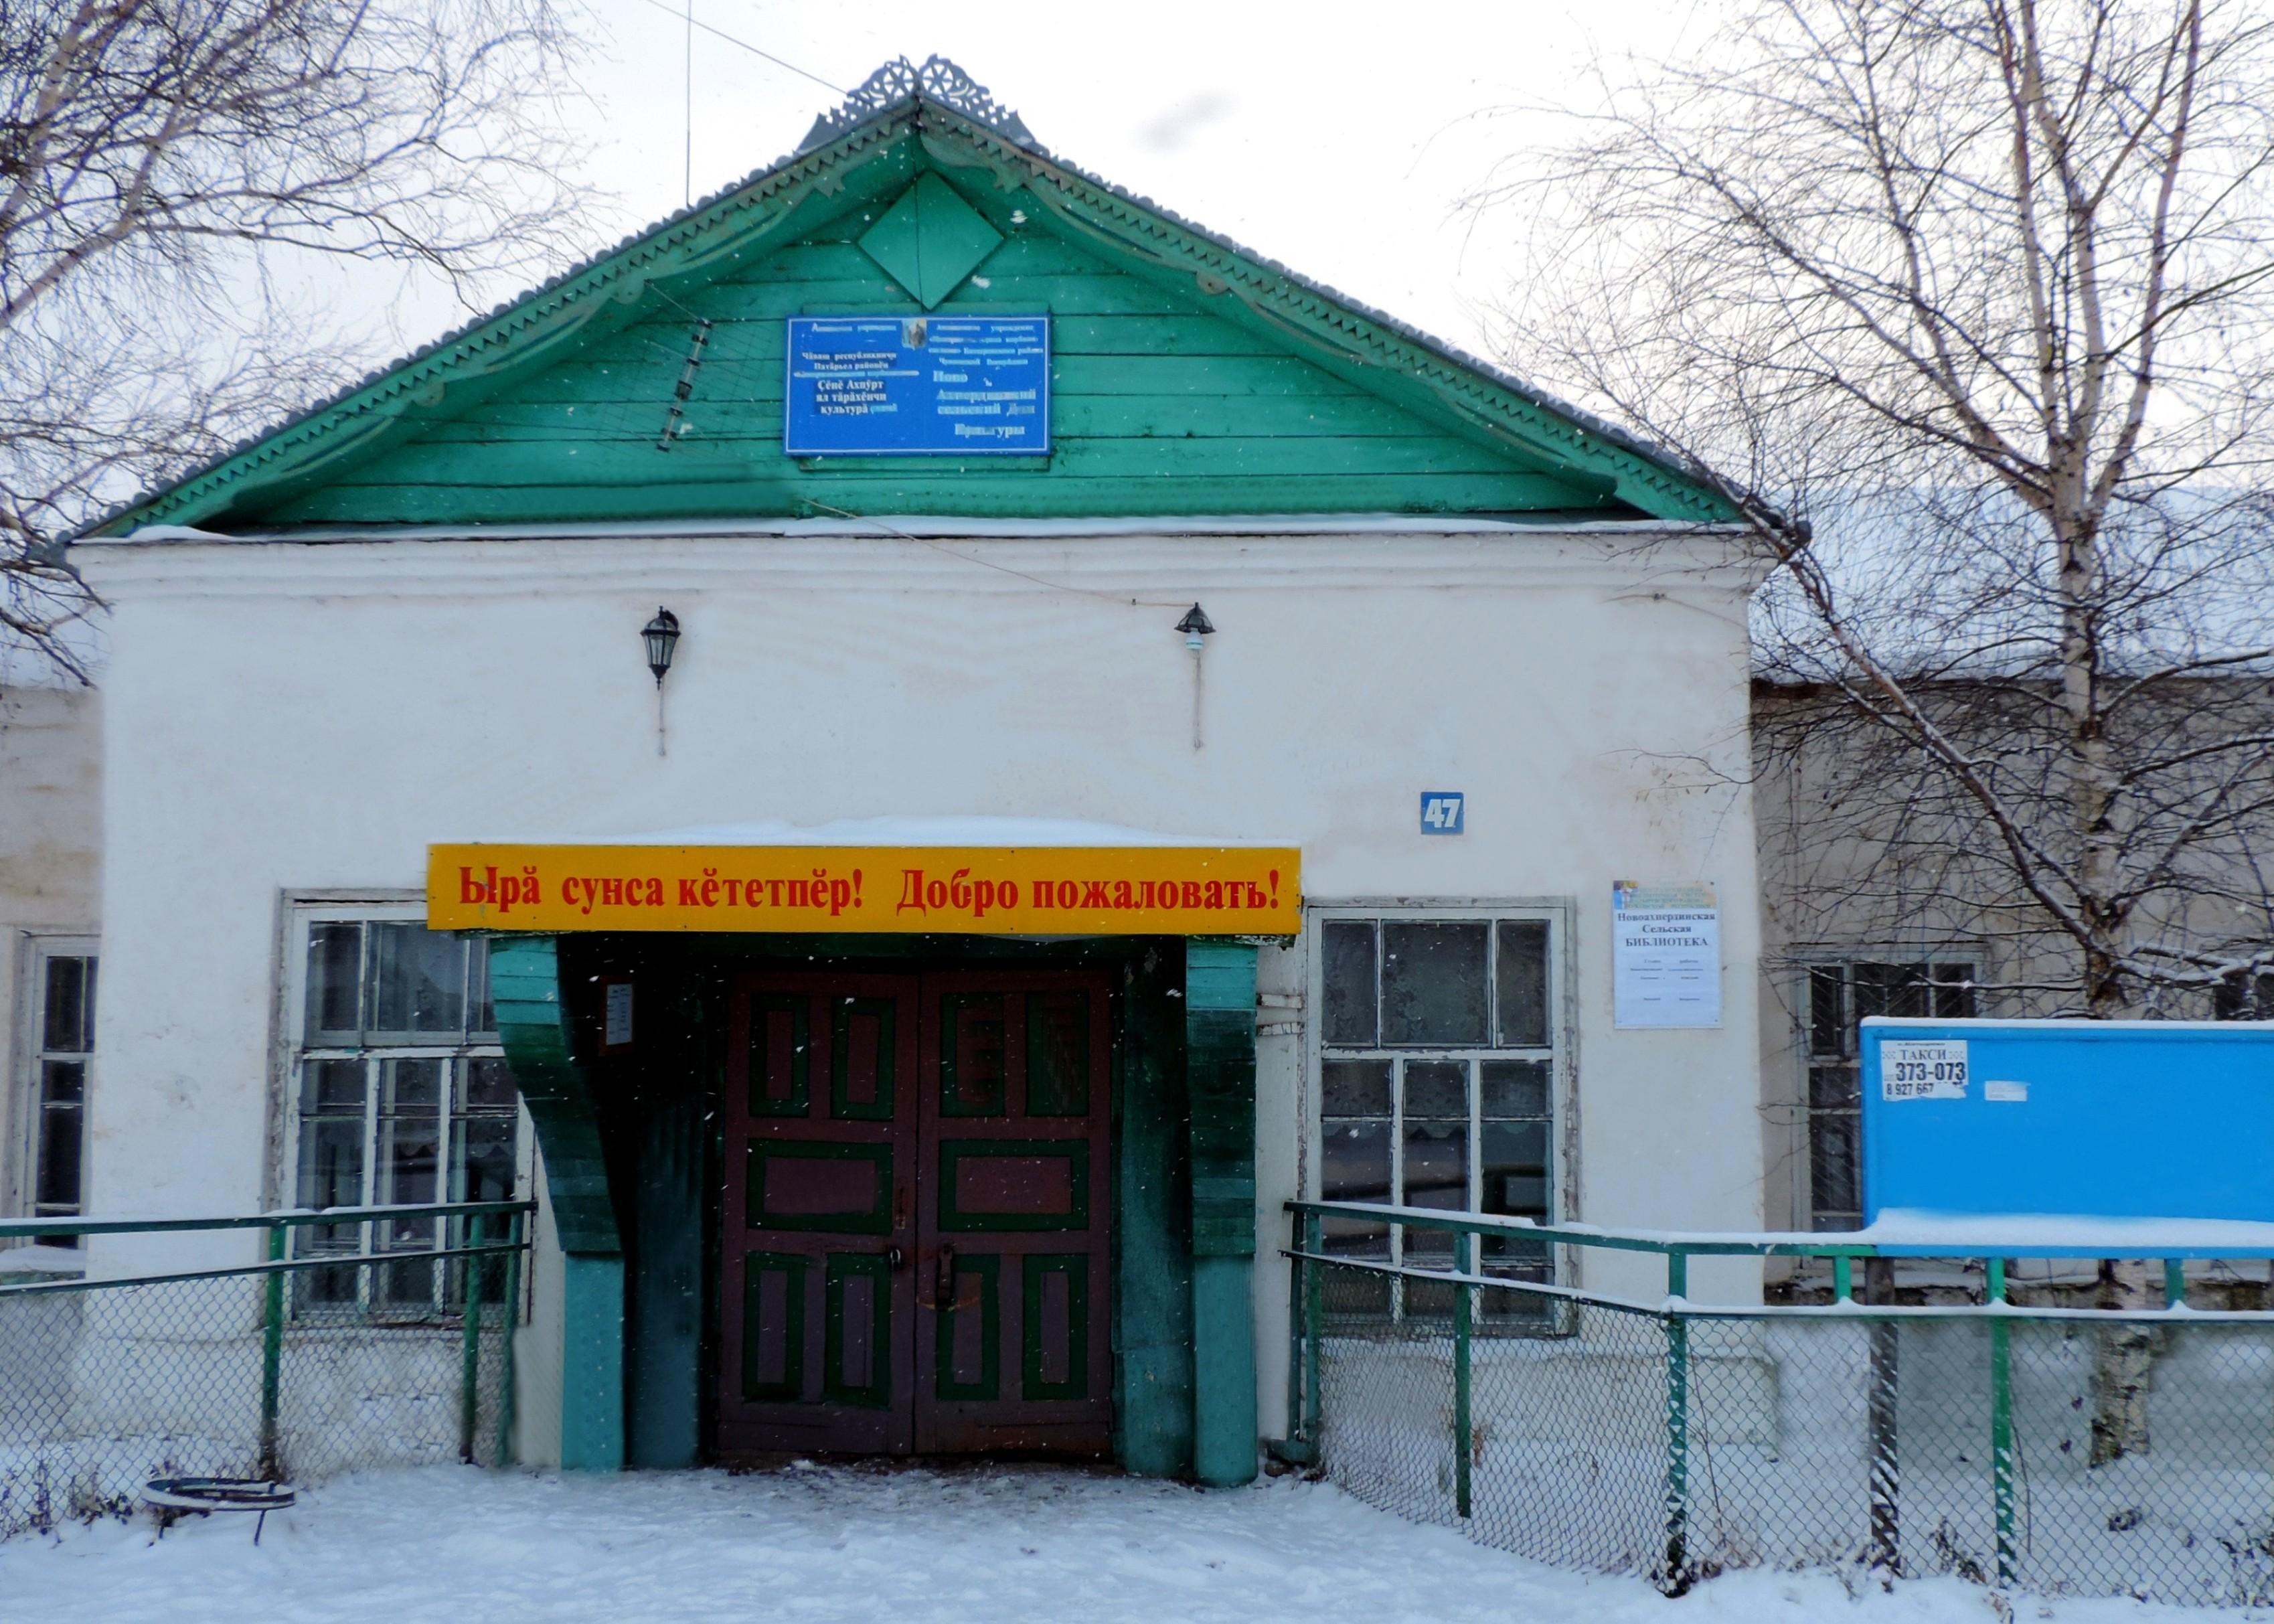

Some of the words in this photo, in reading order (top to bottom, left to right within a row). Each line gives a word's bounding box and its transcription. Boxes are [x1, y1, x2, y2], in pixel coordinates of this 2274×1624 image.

[1424, 799, 1461, 827] 47
[562, 877, 665, 915] сунса
[896, 868, 1019, 917] Добро
[1032, 869, 1280, 910] пожаловать!
[1642, 924, 1692, 933] Сельская
[1625, 937, 1708, 947] БИБЛИОТЕКА
[1900, 1049, 1947, 1060] ТАКСИ
[1895, 1062, 1965, 1082] 373-073
[1886, 1083, 1892, 1095] 8
[1895, 1083, 1913, 1095] 927
